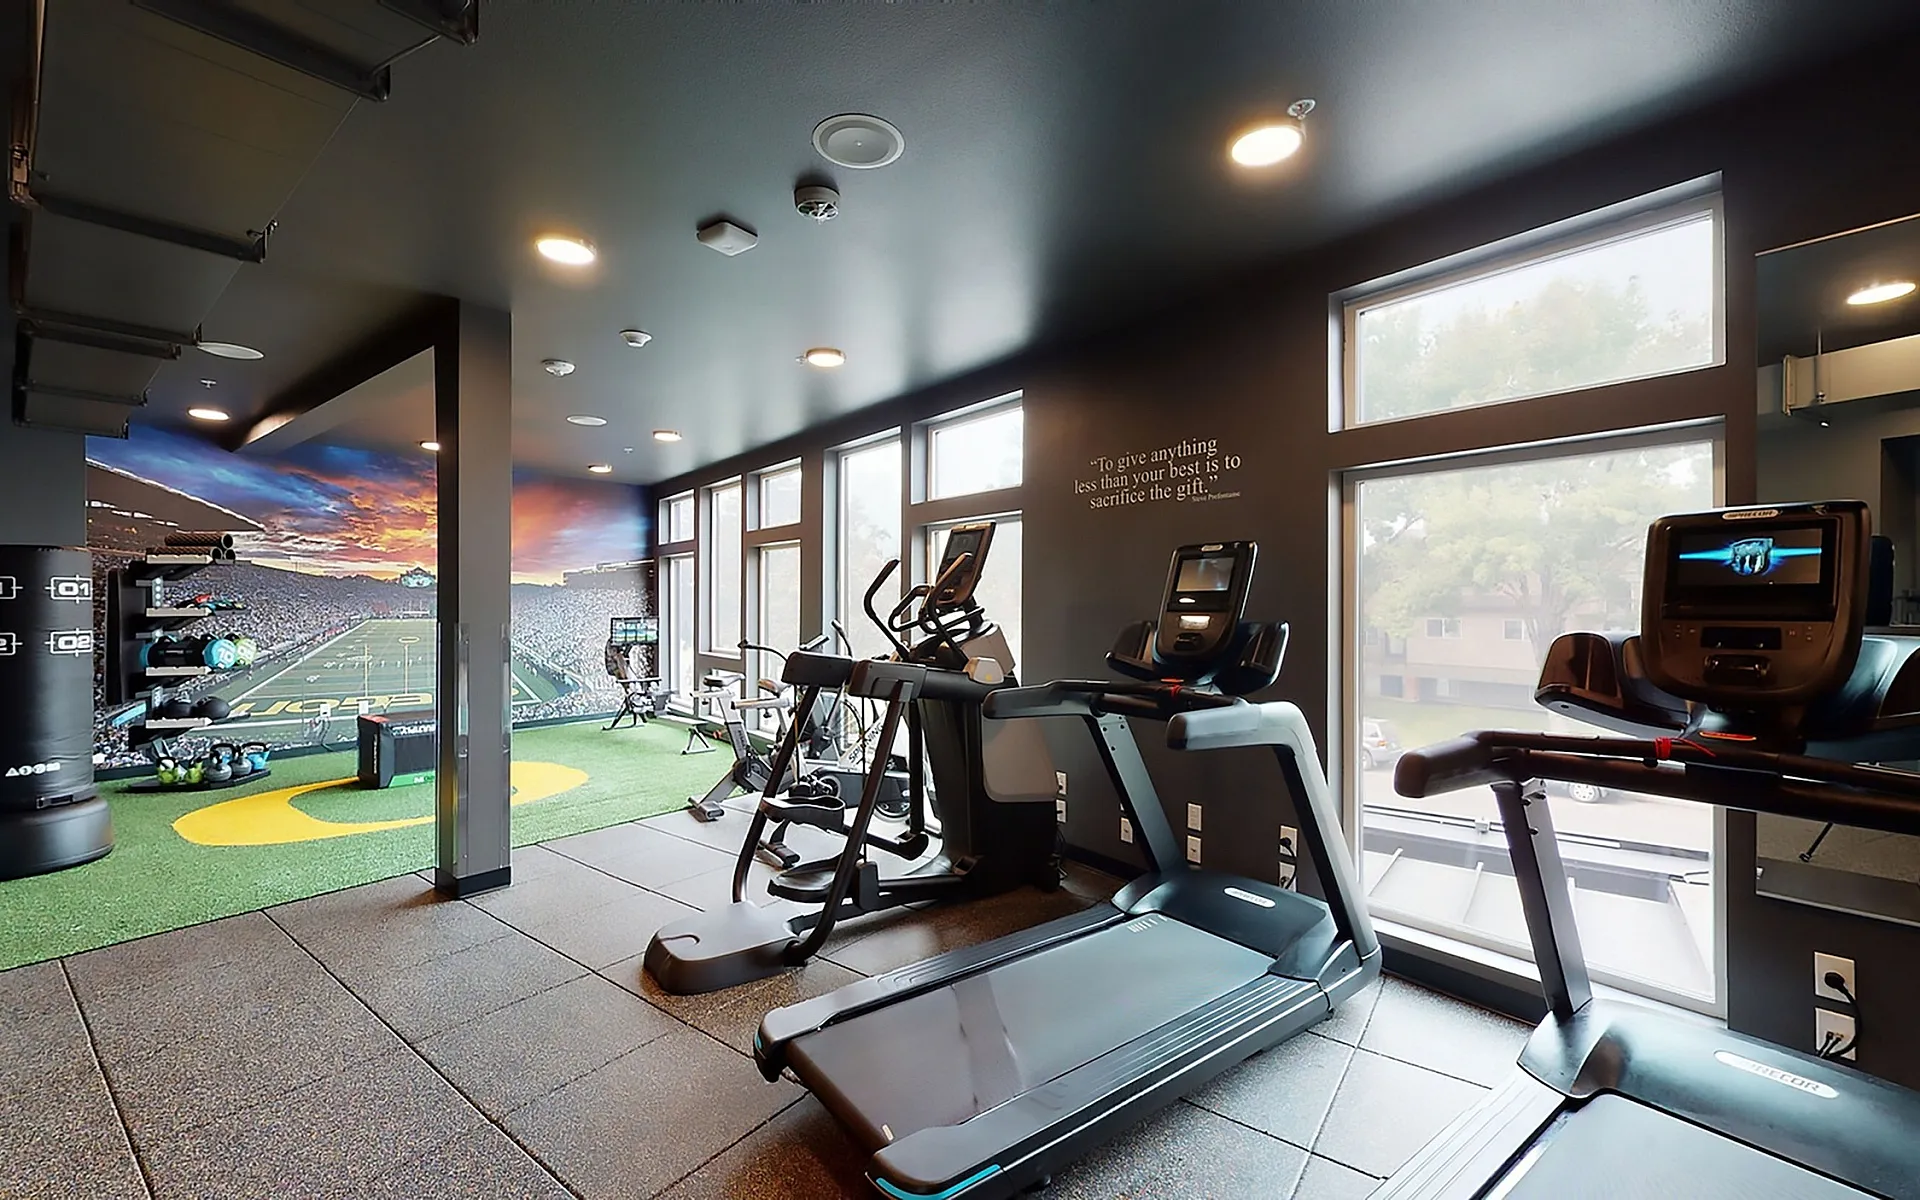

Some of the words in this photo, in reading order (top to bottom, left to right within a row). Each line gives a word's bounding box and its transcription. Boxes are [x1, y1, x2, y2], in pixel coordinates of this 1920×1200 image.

[1090, 456, 1114, 472] “To
[1117, 451, 1147, 473] give
[1150, 438, 1218, 463] anything
[1074, 479, 1098, 494] less
[1100, 473, 1129, 490] than
[1132, 469, 1165, 489] your
[1168, 460, 1199, 479] best
[1206, 455, 1219, 473] is
[1224, 455, 1241, 470] to
[1089, 488, 1146, 510] sacrifice
[1150, 484, 1172, 501] the
[1176, 475, 1219, 501] gift.”
[57, 634, 91, 650] 02
